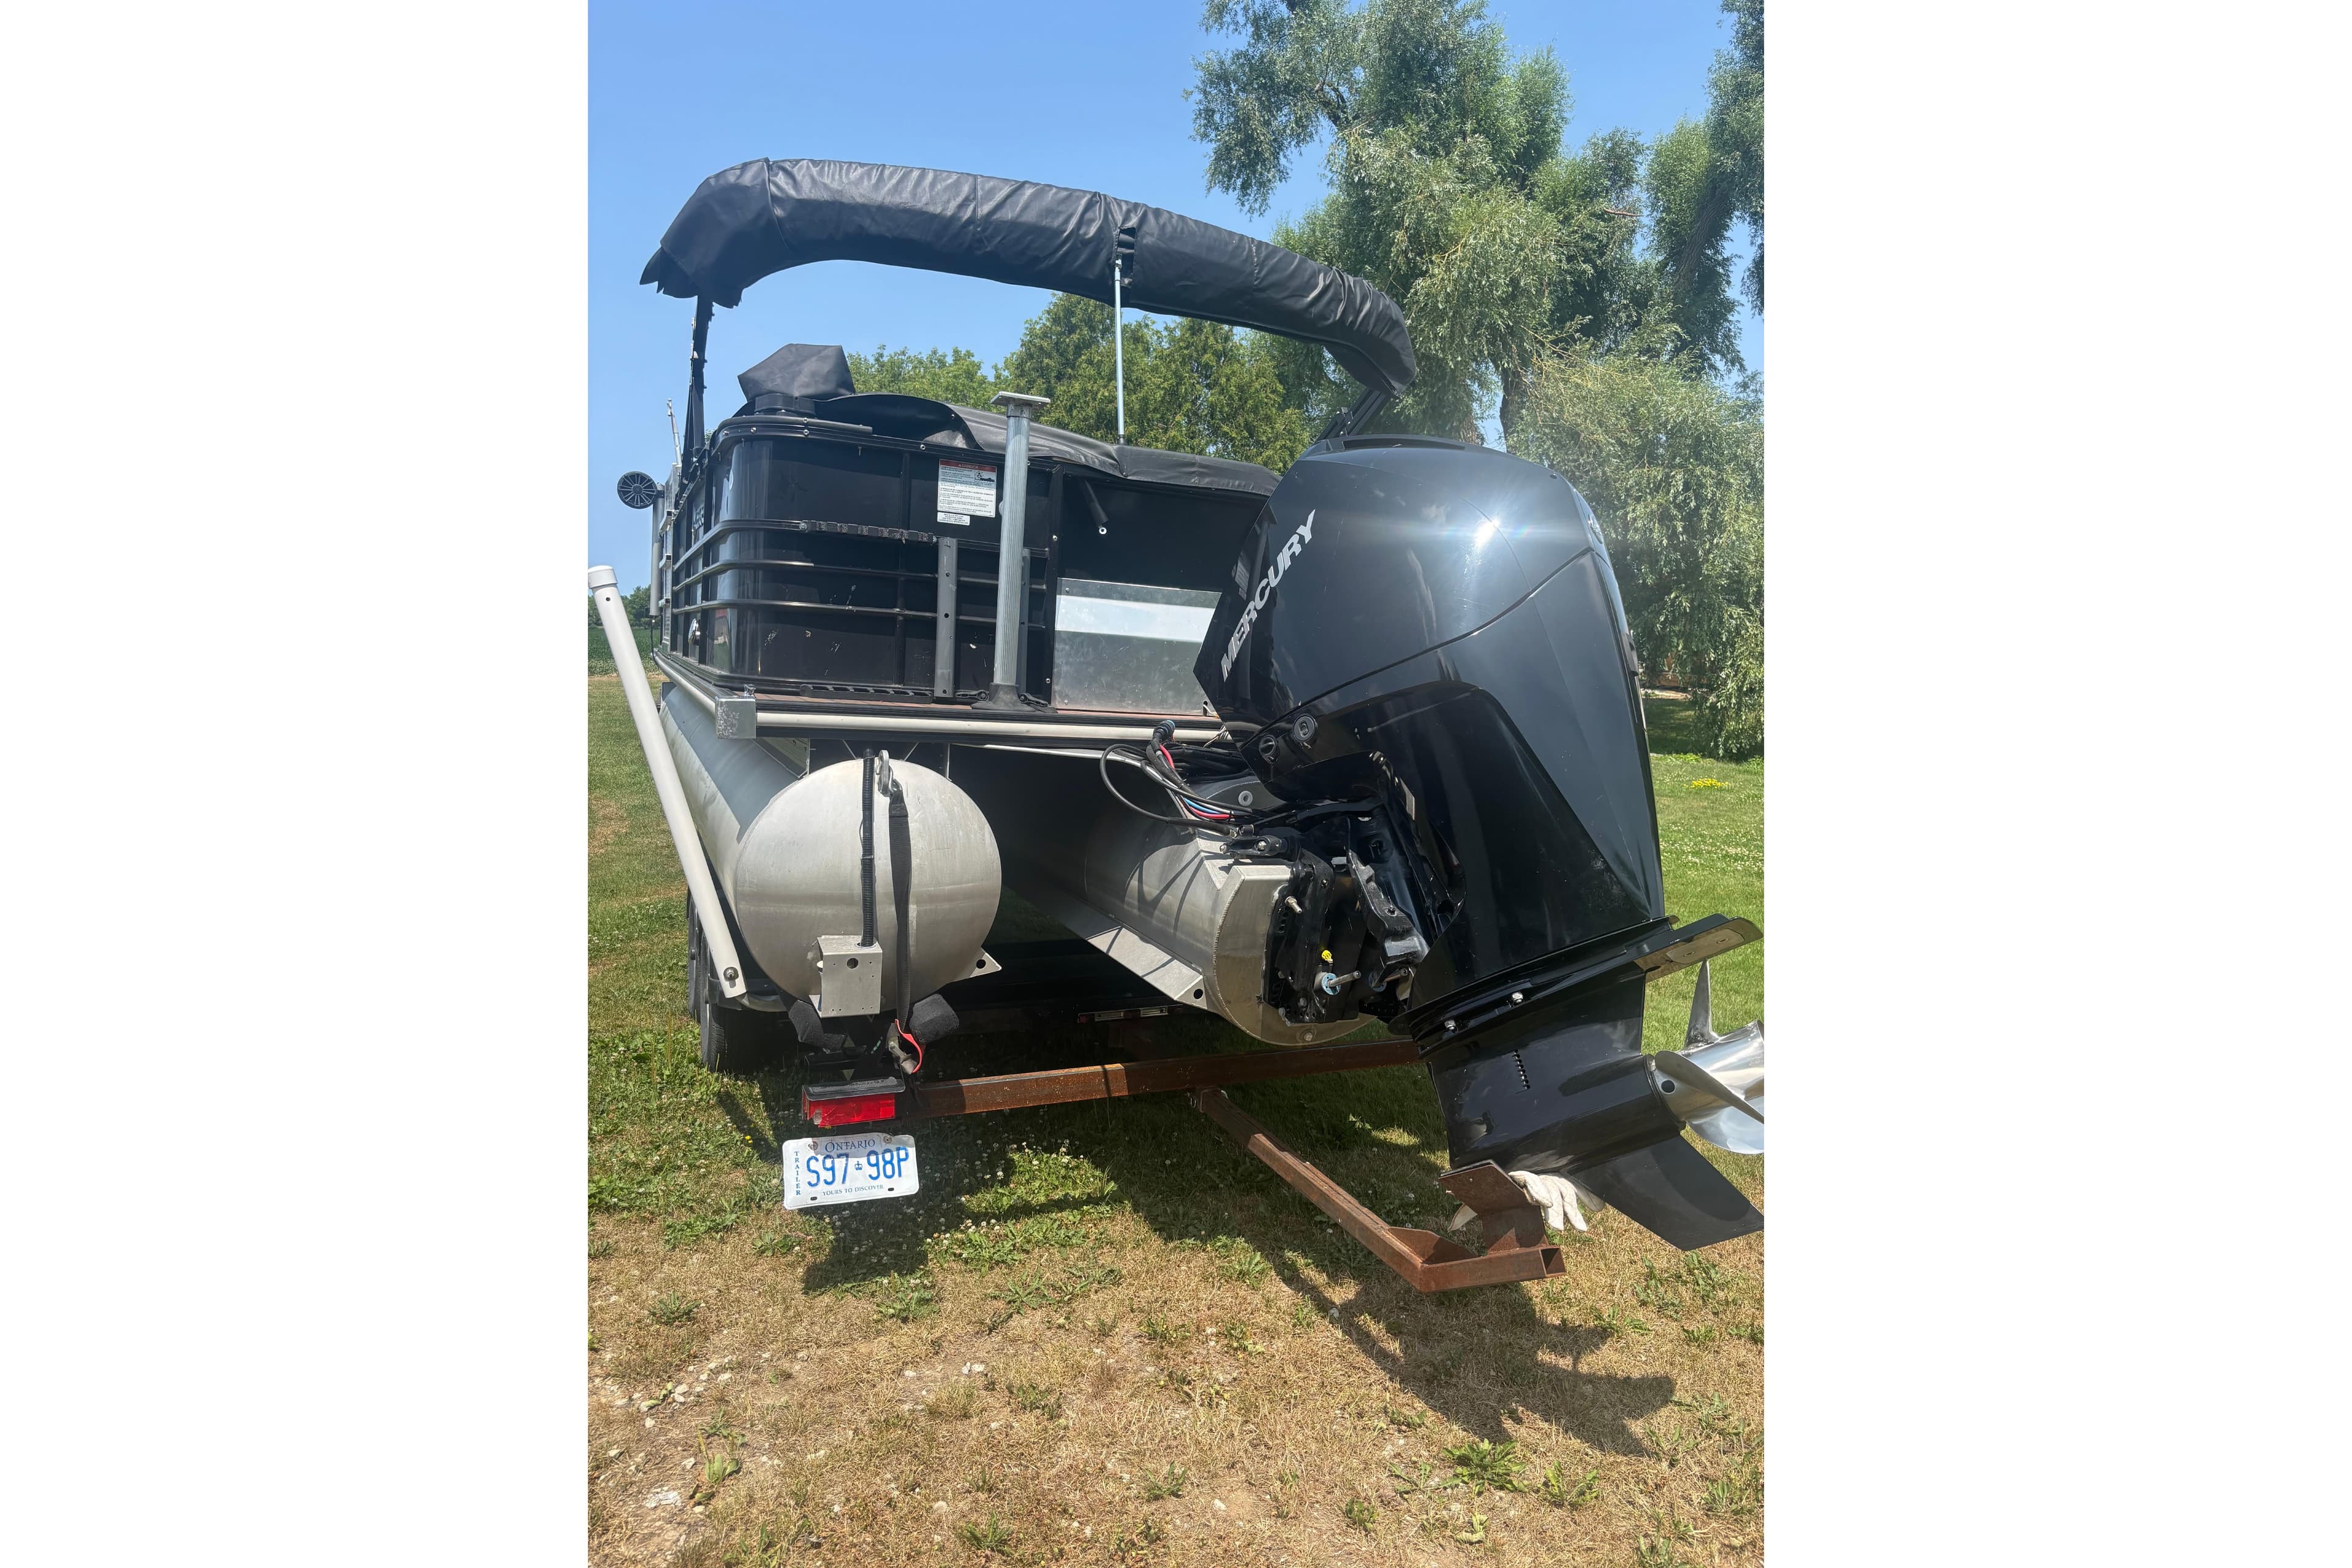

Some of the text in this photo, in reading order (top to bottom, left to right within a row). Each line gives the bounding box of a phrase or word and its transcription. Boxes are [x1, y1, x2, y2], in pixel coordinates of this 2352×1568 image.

[1221, 509, 1316, 683] MERCURY
[825, 1139, 875, 1152] ONTARIO
[806, 1146, 910, 1187] S97 98P
